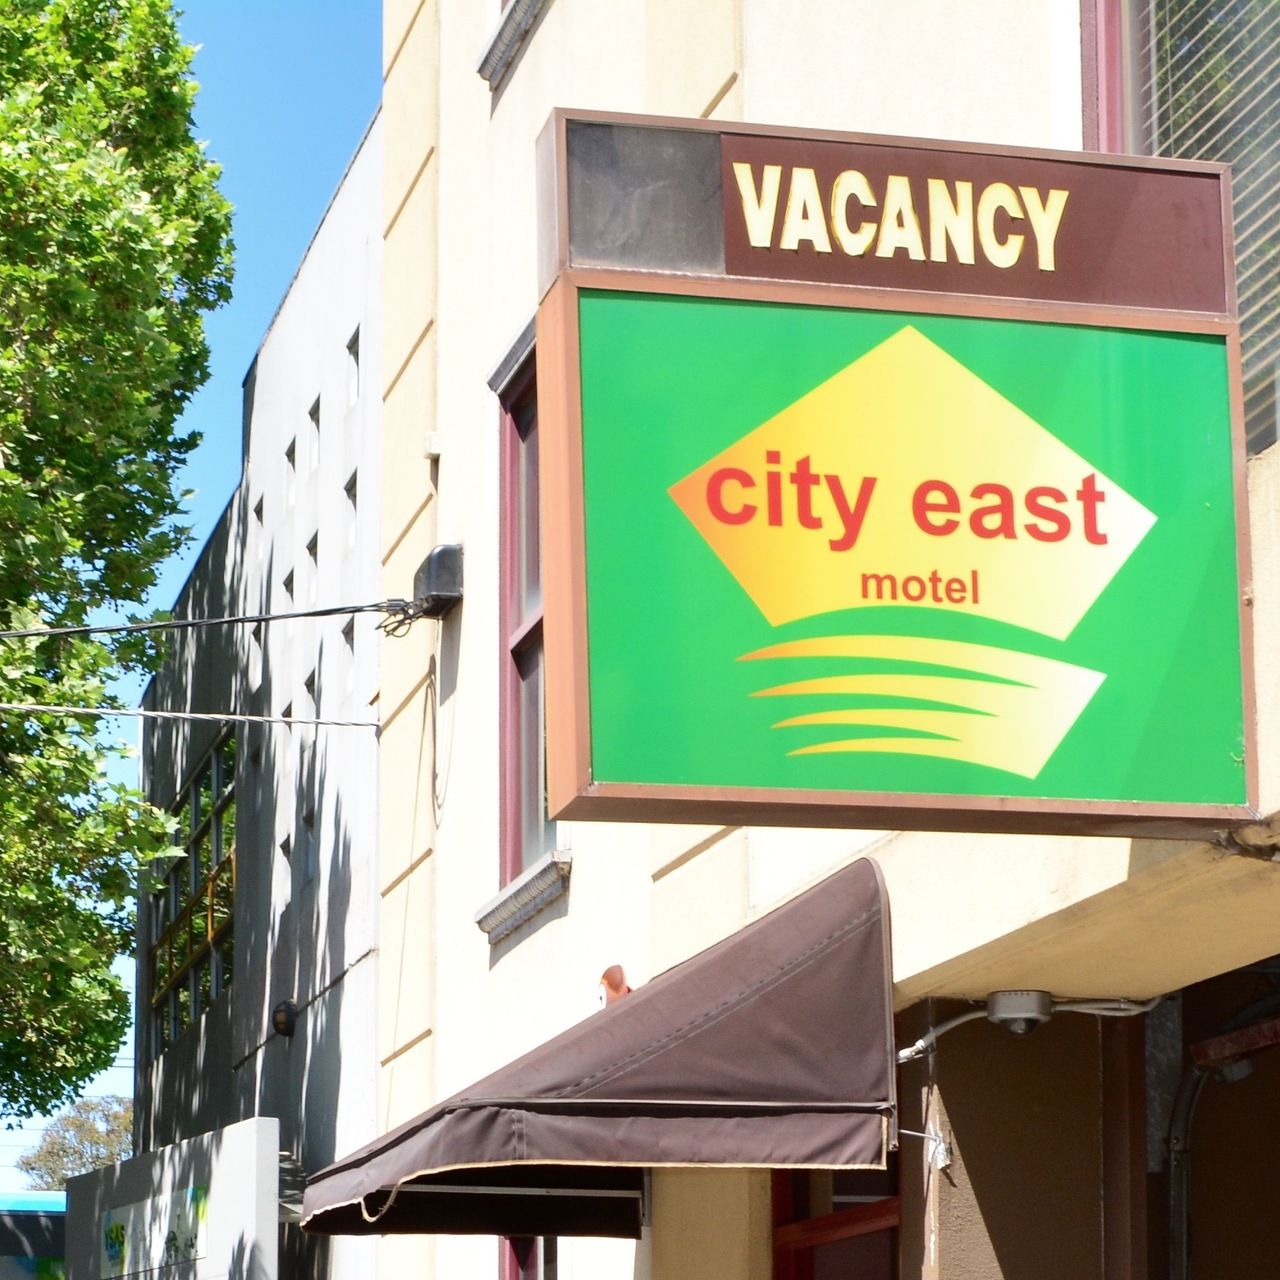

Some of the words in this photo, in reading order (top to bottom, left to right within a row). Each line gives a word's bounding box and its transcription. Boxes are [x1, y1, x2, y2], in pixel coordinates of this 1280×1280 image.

[732, 160, 1070, 272] VACANCY
[705, 450, 878, 552] city
[911, 472, 1110, 546] east
[860, 569, 980, 605] motel
